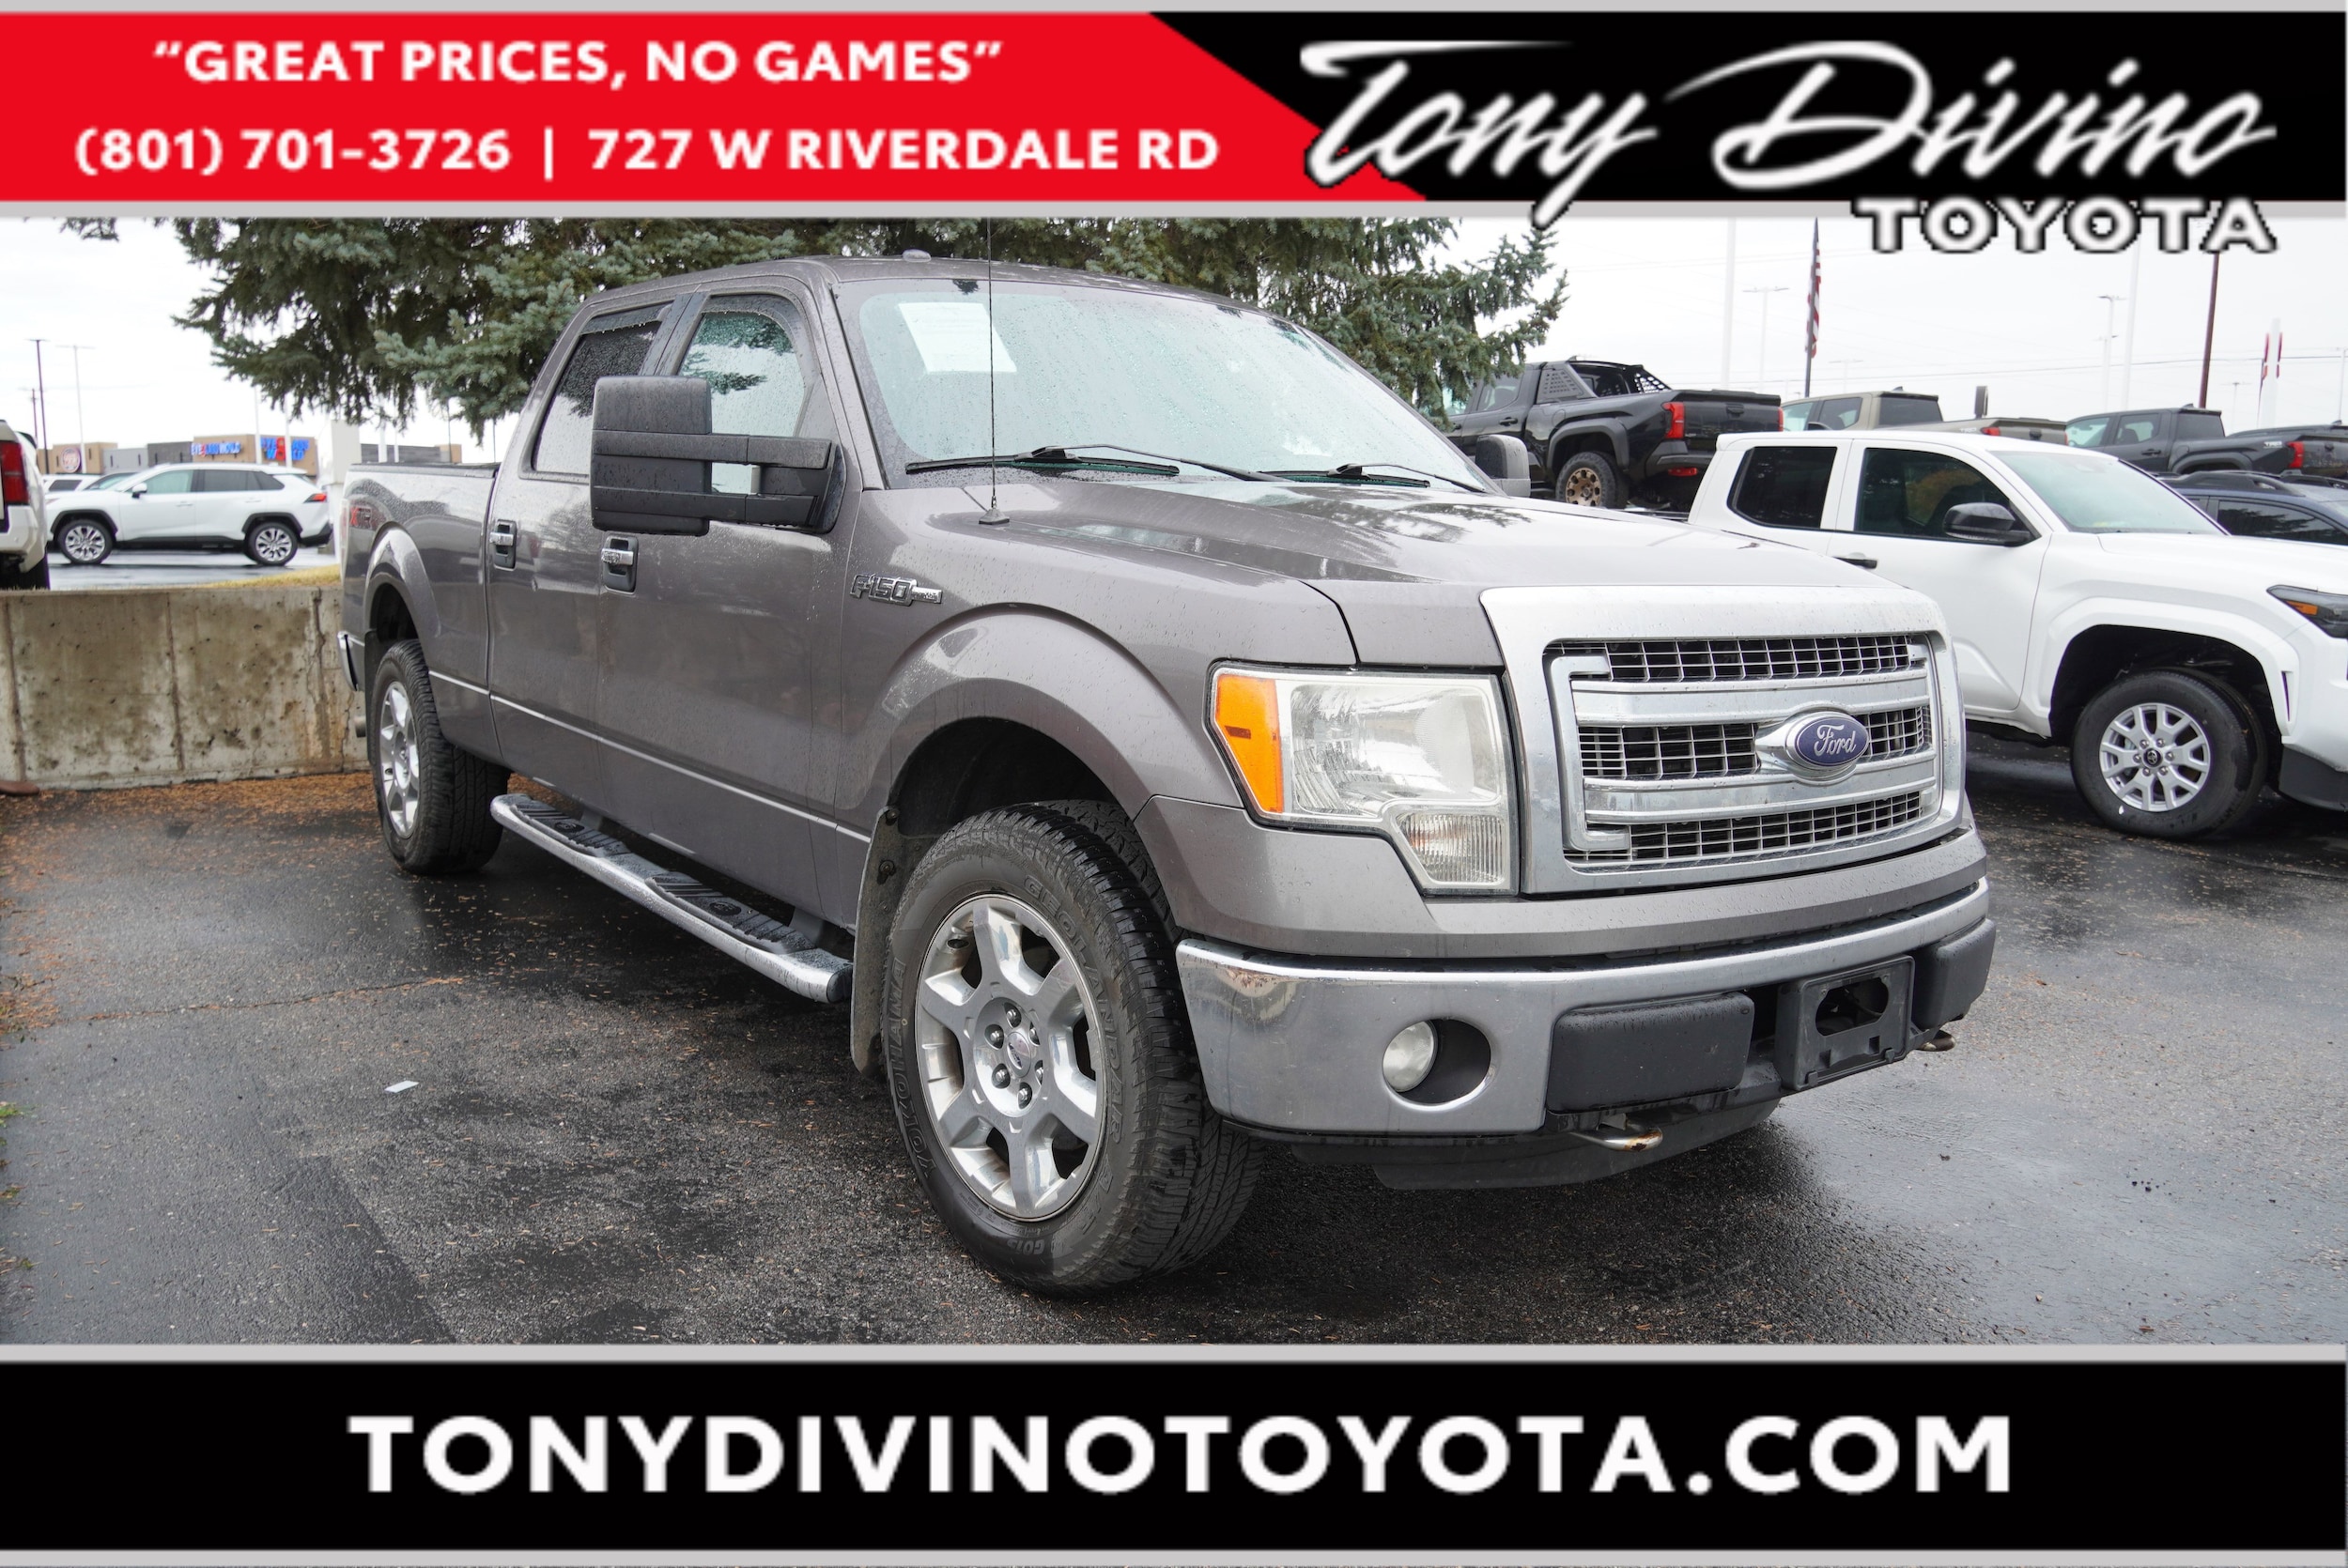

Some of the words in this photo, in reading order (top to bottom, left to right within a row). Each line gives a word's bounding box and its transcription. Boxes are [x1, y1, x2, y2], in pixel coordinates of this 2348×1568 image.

[1813, 724, 1858, 757] Ford
[888, 957, 937, 1178] YOKOHAMA
[1025, 874, 1123, 1145] GEOLANDAR
